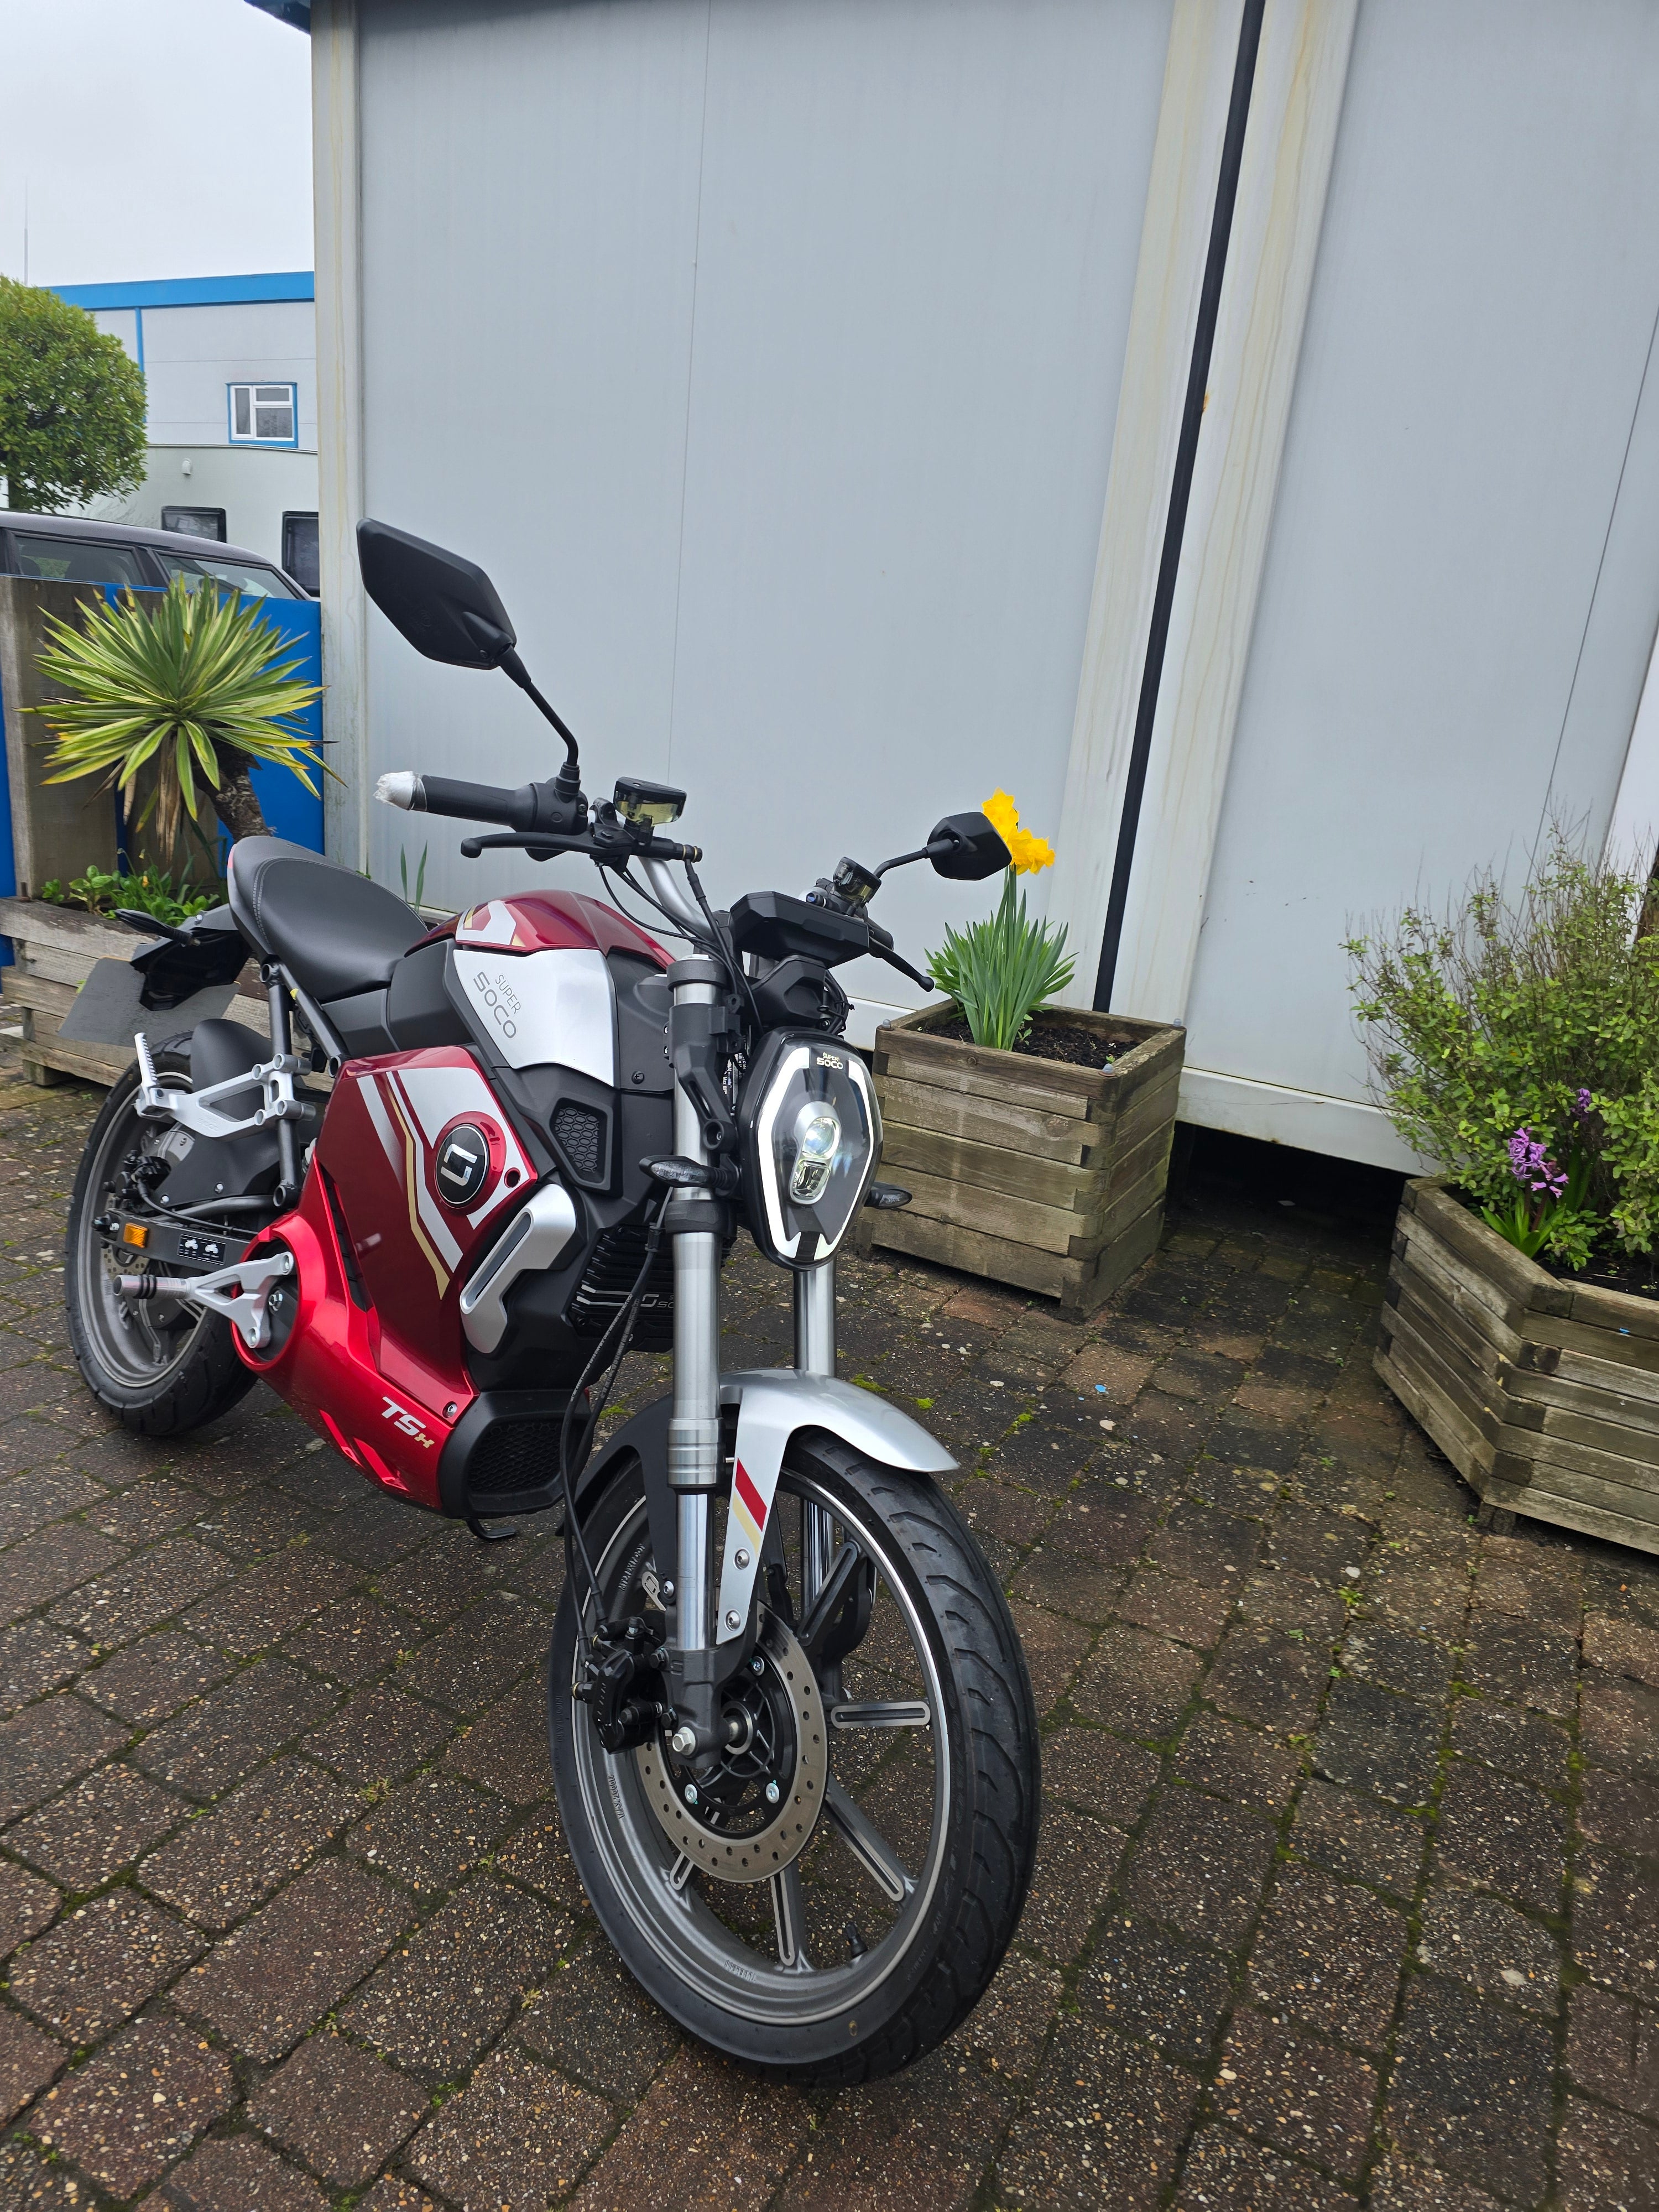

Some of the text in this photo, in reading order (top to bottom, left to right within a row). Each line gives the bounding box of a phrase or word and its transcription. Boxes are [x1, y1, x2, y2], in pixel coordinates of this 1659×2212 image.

[473, 972, 517, 1039] SOCO
[495, 974, 521, 1014] SUPER
[816, 1057, 843, 1070] SOCO
[724, 1960, 757, 1982] TUBELESS
